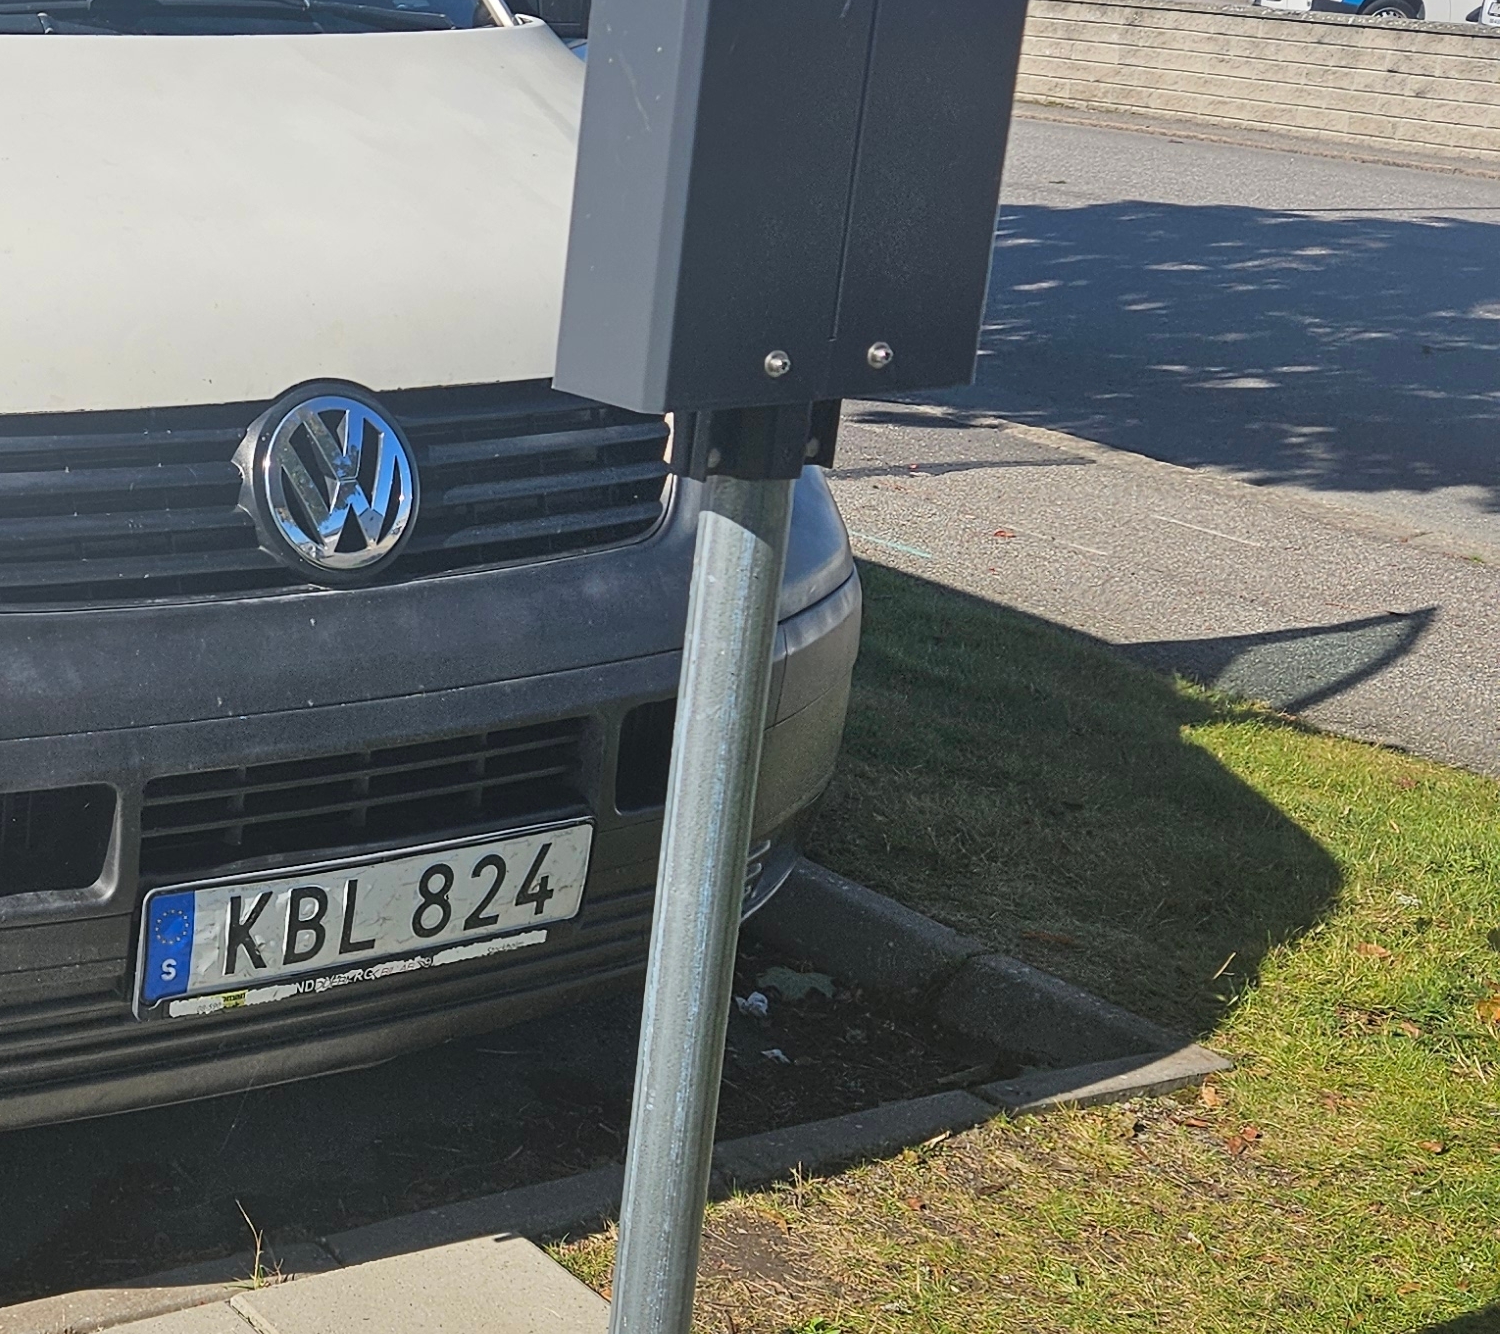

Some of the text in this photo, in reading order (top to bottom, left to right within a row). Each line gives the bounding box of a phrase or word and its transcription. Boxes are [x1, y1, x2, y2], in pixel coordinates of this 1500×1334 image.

[222, 842, 555, 976] KBL 824
[160, 958, 178, 982] S
